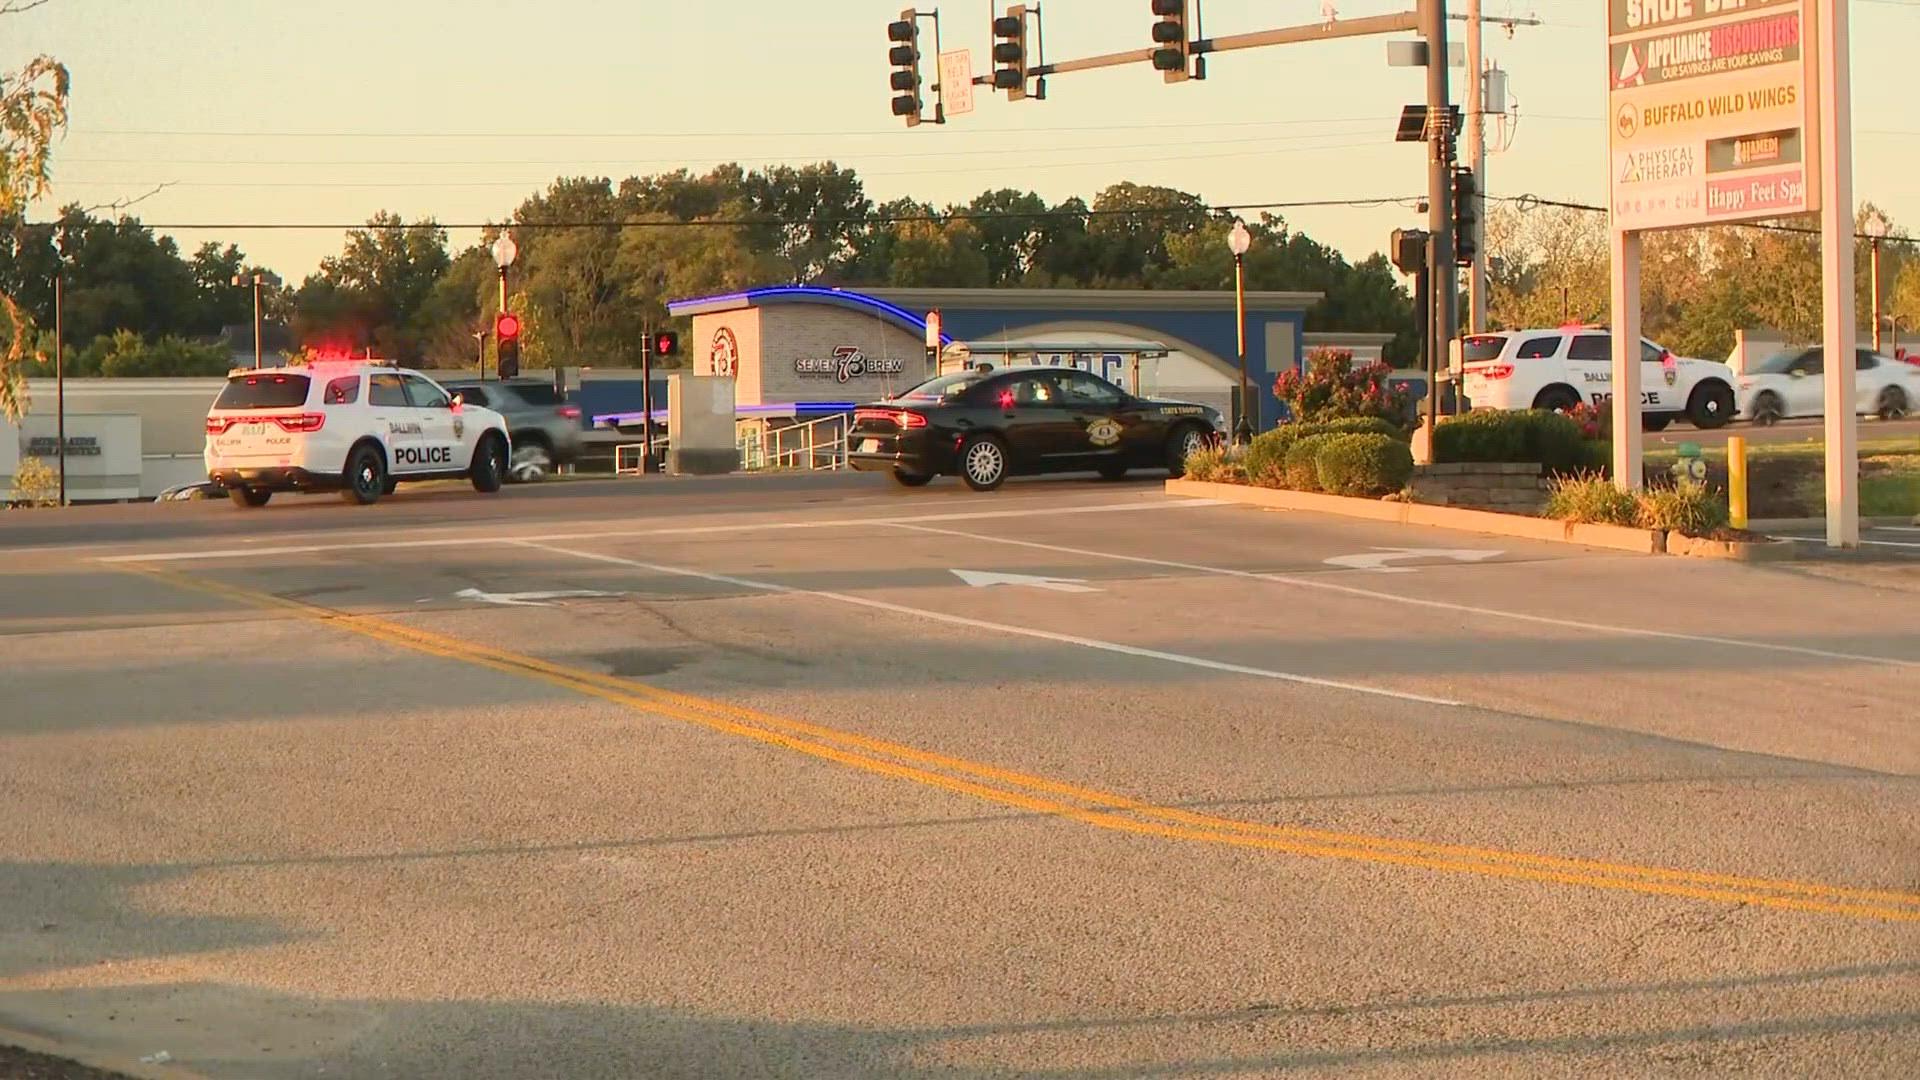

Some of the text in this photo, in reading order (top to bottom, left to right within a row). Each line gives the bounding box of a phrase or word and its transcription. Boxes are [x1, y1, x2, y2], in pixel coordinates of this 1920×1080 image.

[1661, 48, 1783, 80] OUR SAVINGS ARE YOUR SAVINGS
[1644, 85, 1796, 127] BUFFALO WILD WINGS
[1639, 147, 1694, 164] PHYSICAL
[1640, 162, 1695, 181] THERAPY
[1709, 185, 1745, 210] Happy
[1751, 181, 1775, 203] Feet
[1780, 178, 1802, 200] Spa
[796, 358, 836, 372] SEVEN
[867, 358, 905, 372] BREW
[265, 437, 291, 445] POLICE
[394, 446, 452, 465] POLICE
